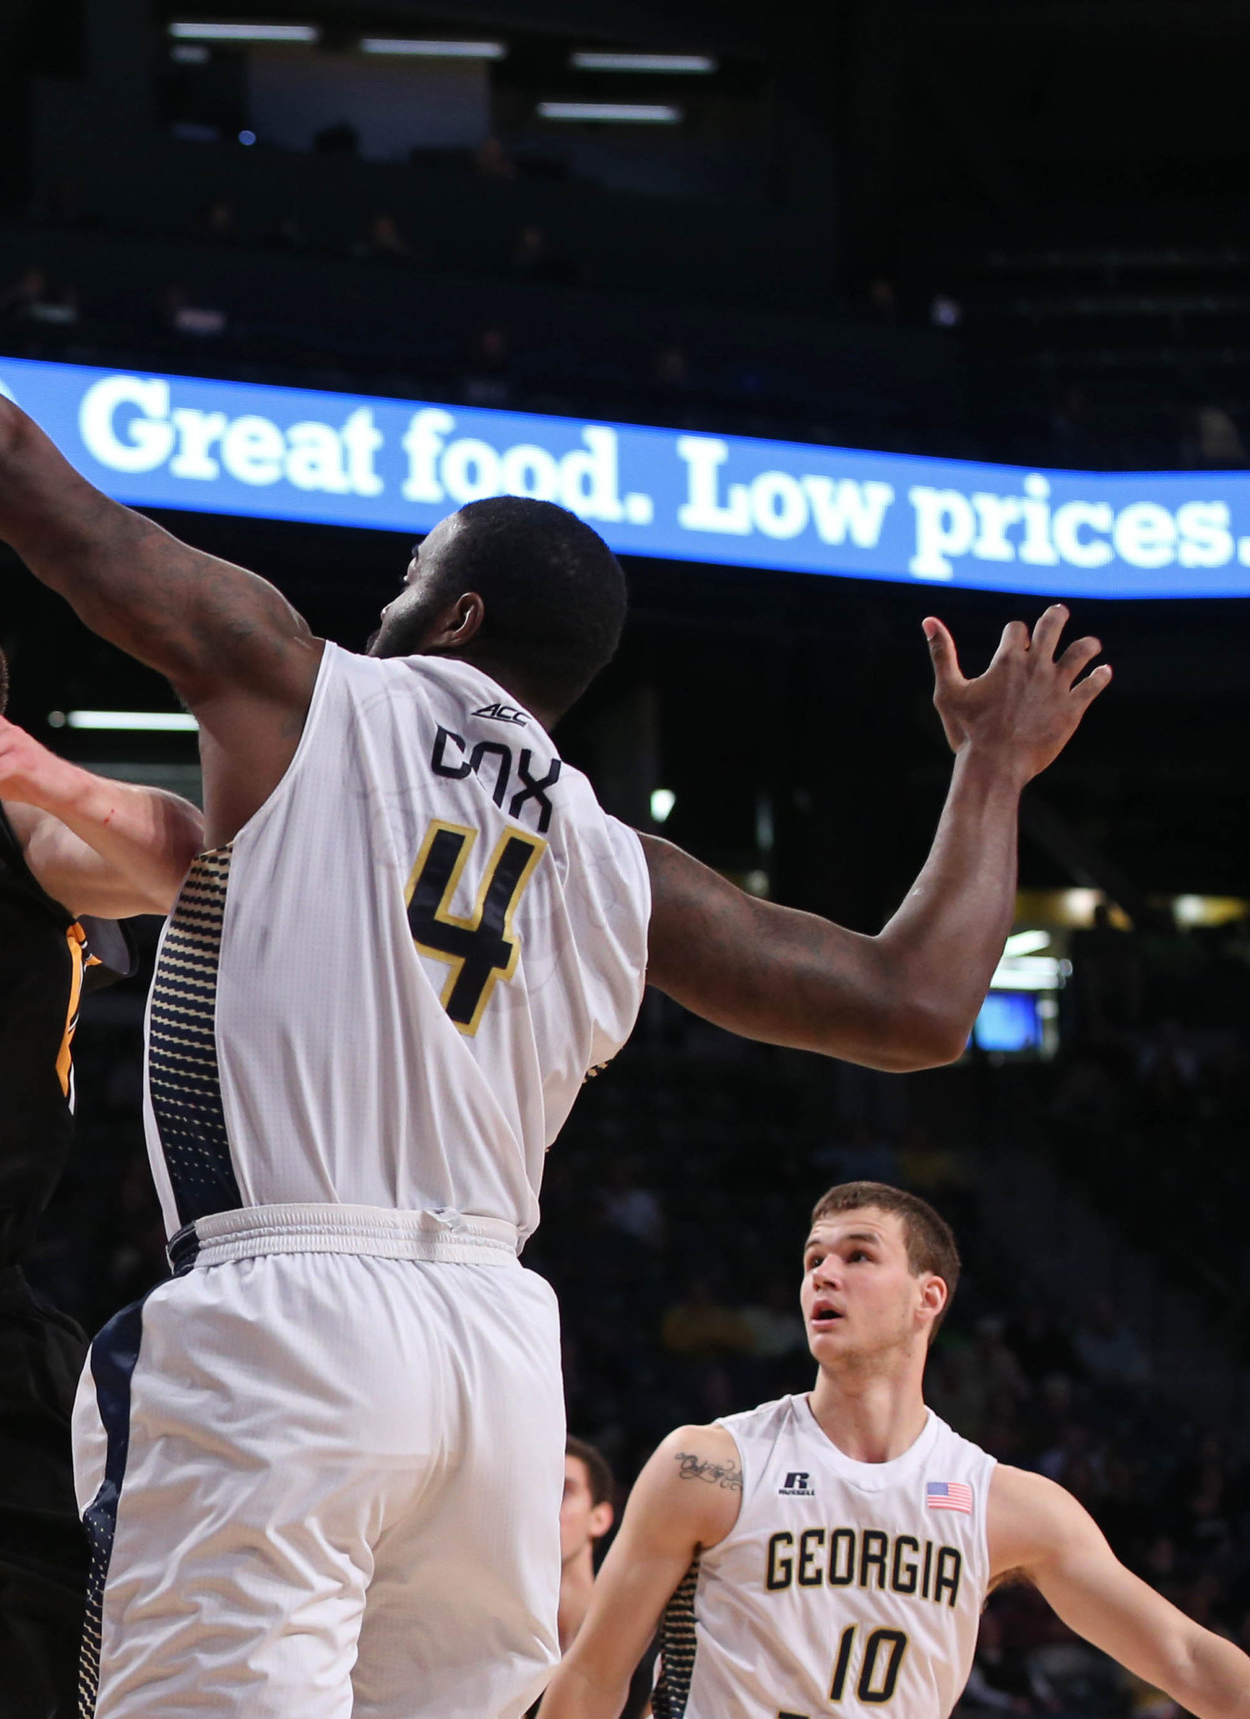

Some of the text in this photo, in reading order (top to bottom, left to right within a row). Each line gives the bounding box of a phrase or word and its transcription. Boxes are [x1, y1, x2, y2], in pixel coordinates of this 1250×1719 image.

[79, 375, 384, 498] Great
[401, 407, 653, 526] food.
[677, 436, 895, 549] Low
[470, 703, 532, 727] ACC
[404, 817, 549, 1038] 4
[764, 1527, 963, 1610] GEORGIA
[828, 1622, 910, 1706] 10
